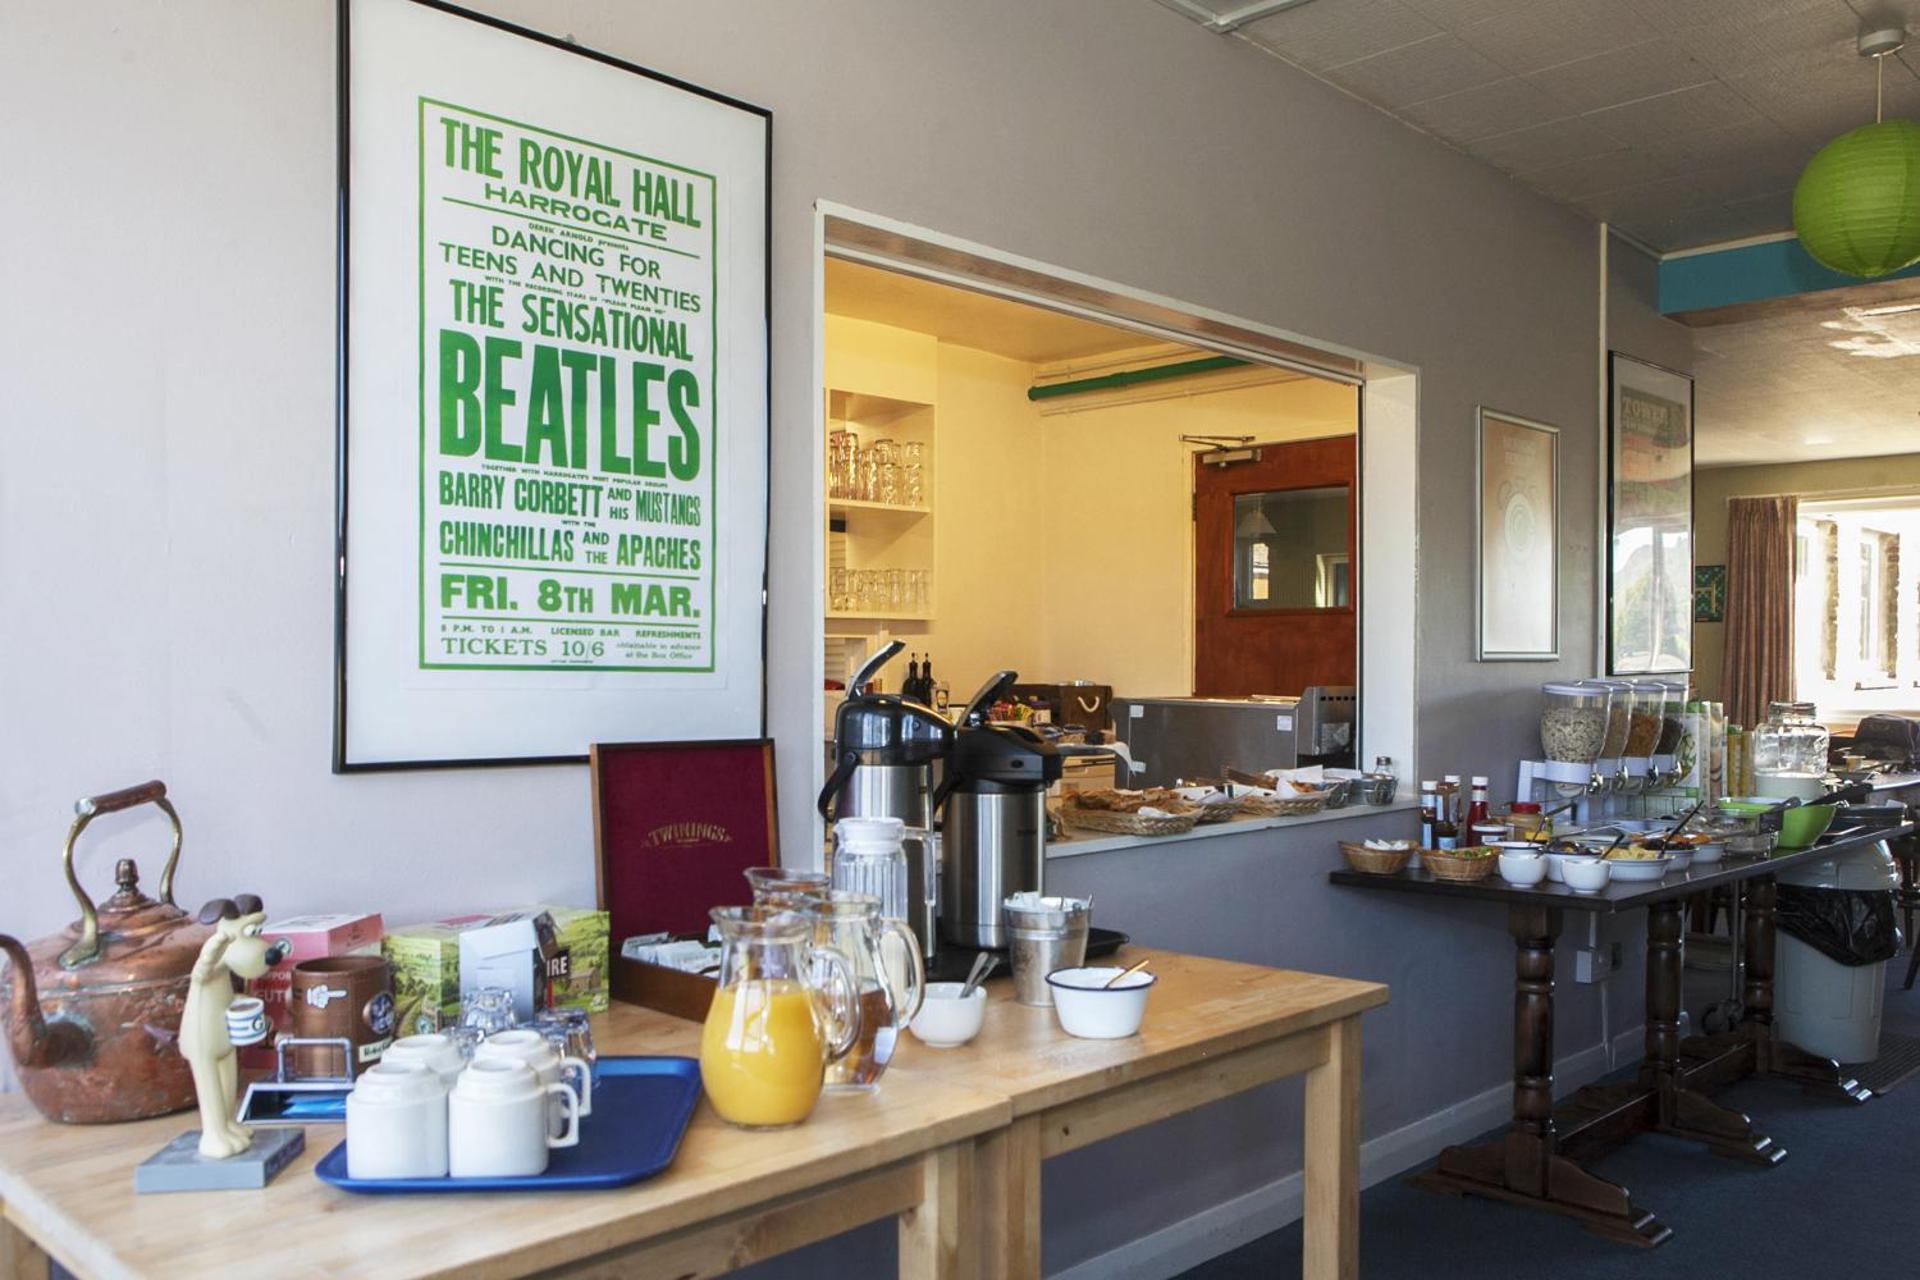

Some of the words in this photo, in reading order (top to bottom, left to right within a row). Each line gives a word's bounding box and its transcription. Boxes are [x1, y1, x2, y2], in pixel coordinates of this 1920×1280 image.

[440, 116, 503, 179] THE
[520, 137, 620, 207] ROYAL
[633, 168, 701, 228] HALL
[485, 183, 667, 242] HARROGATE
[492, 225, 604, 267] DANCING
[620, 254, 661, 279] FOR
[560, 230, 594, 242] ARNOLD
[439, 242, 517, 274] TEENS
[532, 262, 584, 288] AND
[596, 274, 700, 312] TWENTIES
[450, 279, 504, 328] THE
[522, 294, 694, 362] SENSATIONAL
[440, 328, 700, 482] BEATLES
[440, 470, 505, 510] BARRY
[514, 478, 603, 518] CORBETT
[608, 488, 632, 501] AND
[636, 490, 700, 526] MUSTANGS
[562, 519, 580, 527] WITH
[610, 506, 628, 520] HIS
[440, 521, 574, 562] CHINCHILLAS
[582, 532, 610, 545] AND
[616, 534, 700, 570] APACHES
[586, 551, 608, 564] THE
[440, 574, 518, 610] FRI.
[538, 579, 593, 613] 8TH
[611, 582, 700, 618] MAR.
[441, 638, 548, 656] TICKETS
[562, 640, 604, 658] 10/6
[454, 624, 474, 632] P.M.
[511, 626, 533, 634] A.M.
[551, 627, 594, 636] LICENSED
[600, 628, 619, 637] BAR
[636, 630, 700, 640] REFRESHMENTS
[648, 822, 725, 847] TWININGS
[546, 956, 568, 977] IRE
